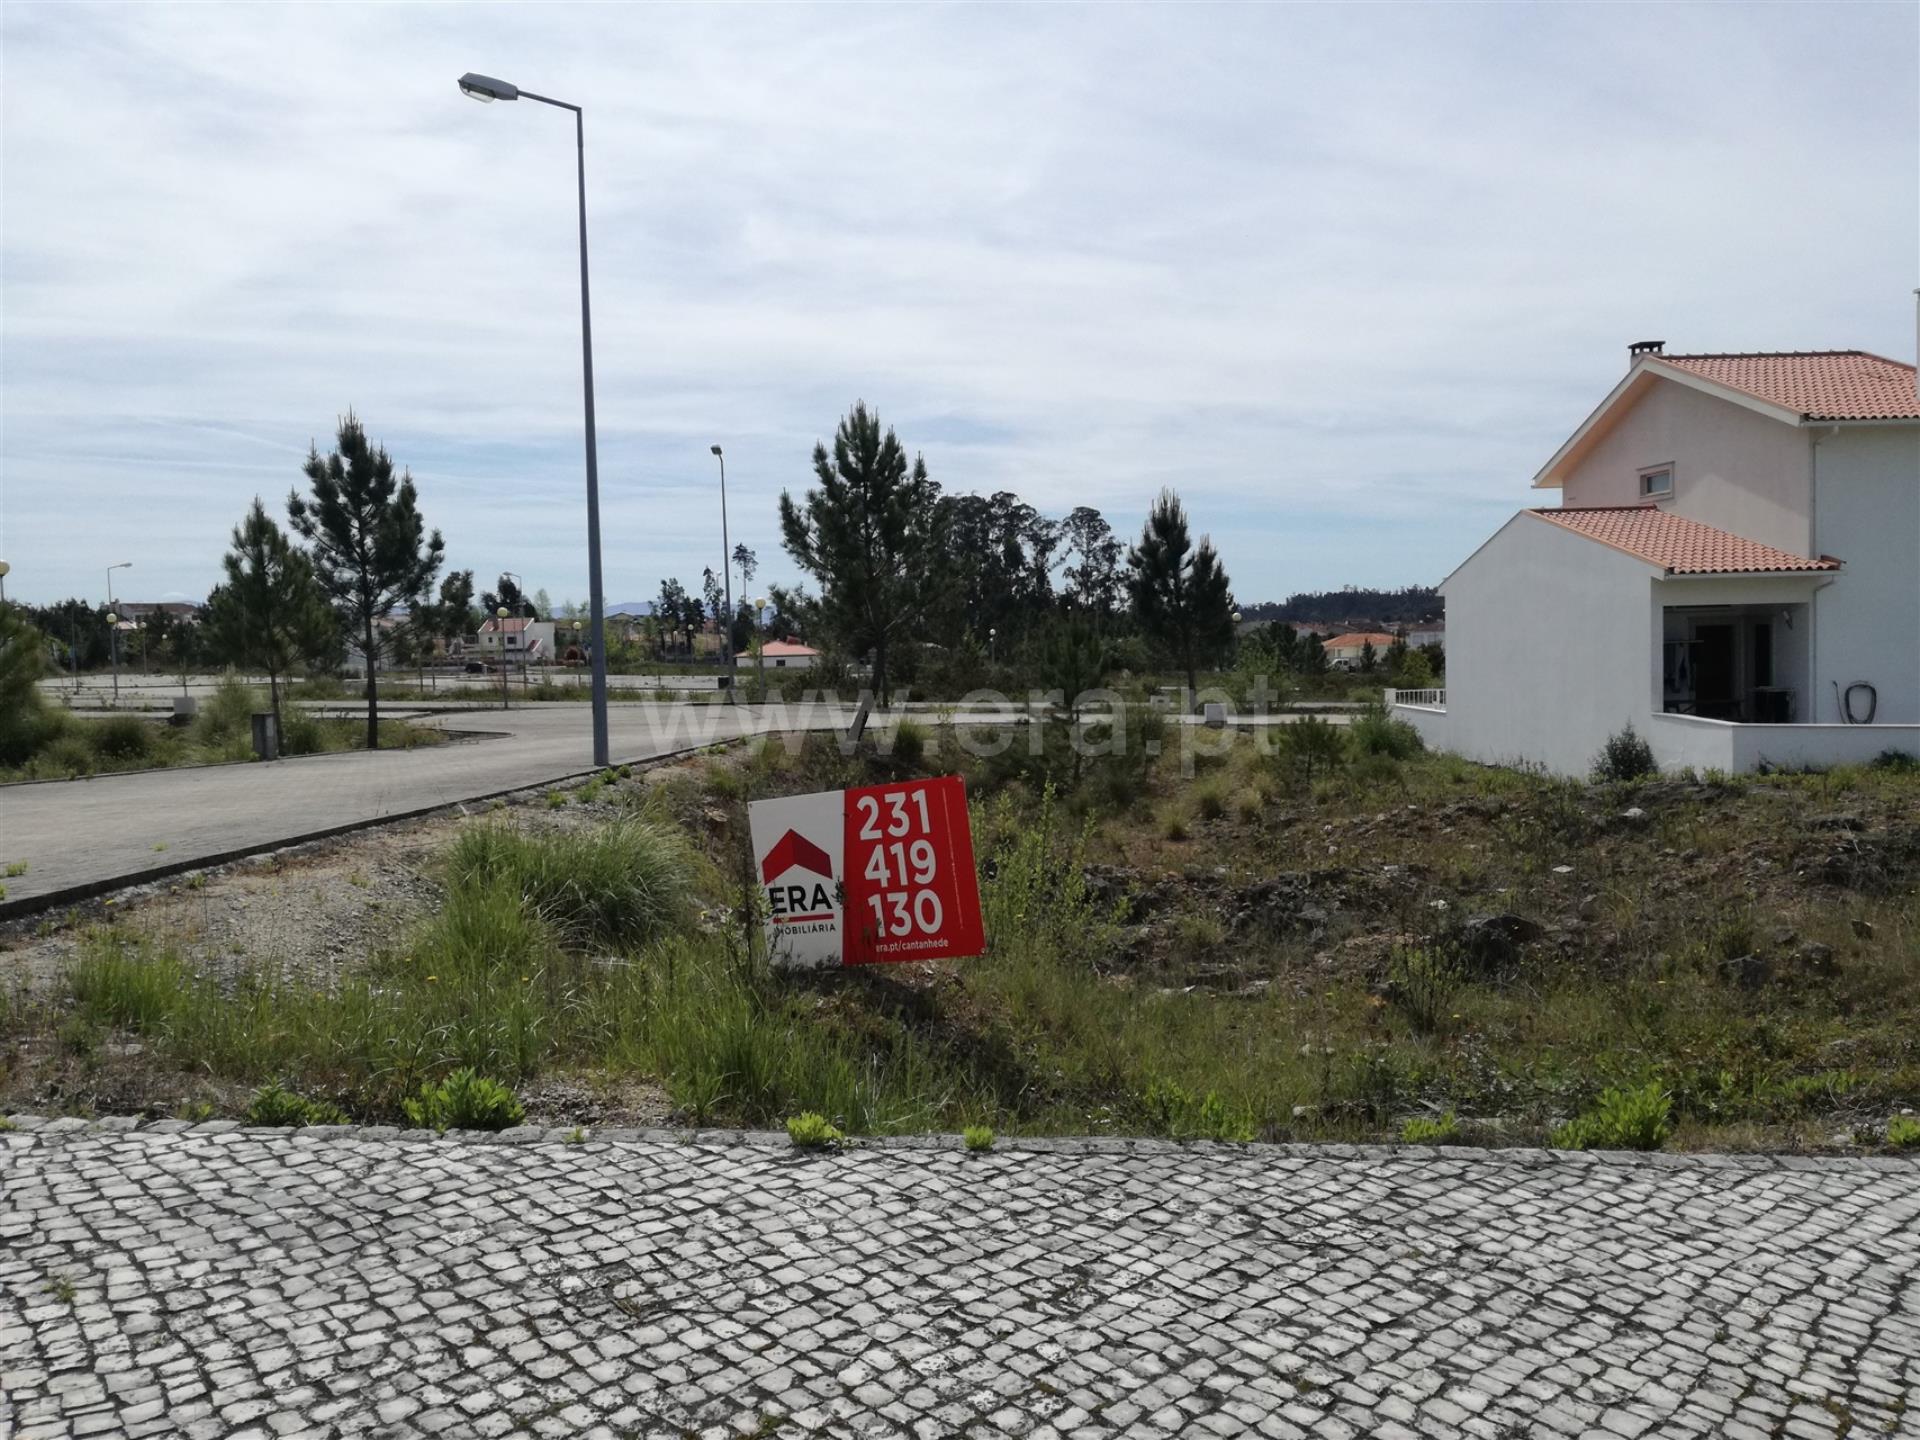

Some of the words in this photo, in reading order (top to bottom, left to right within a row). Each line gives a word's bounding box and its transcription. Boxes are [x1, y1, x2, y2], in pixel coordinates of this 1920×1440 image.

[857, 790, 930, 840] 231
[864, 839, 936, 887] 419
[769, 883, 833, 913] ERA
[868, 889, 943, 937] 130
[876, 938, 949, 953] era.pt/cantanhede
